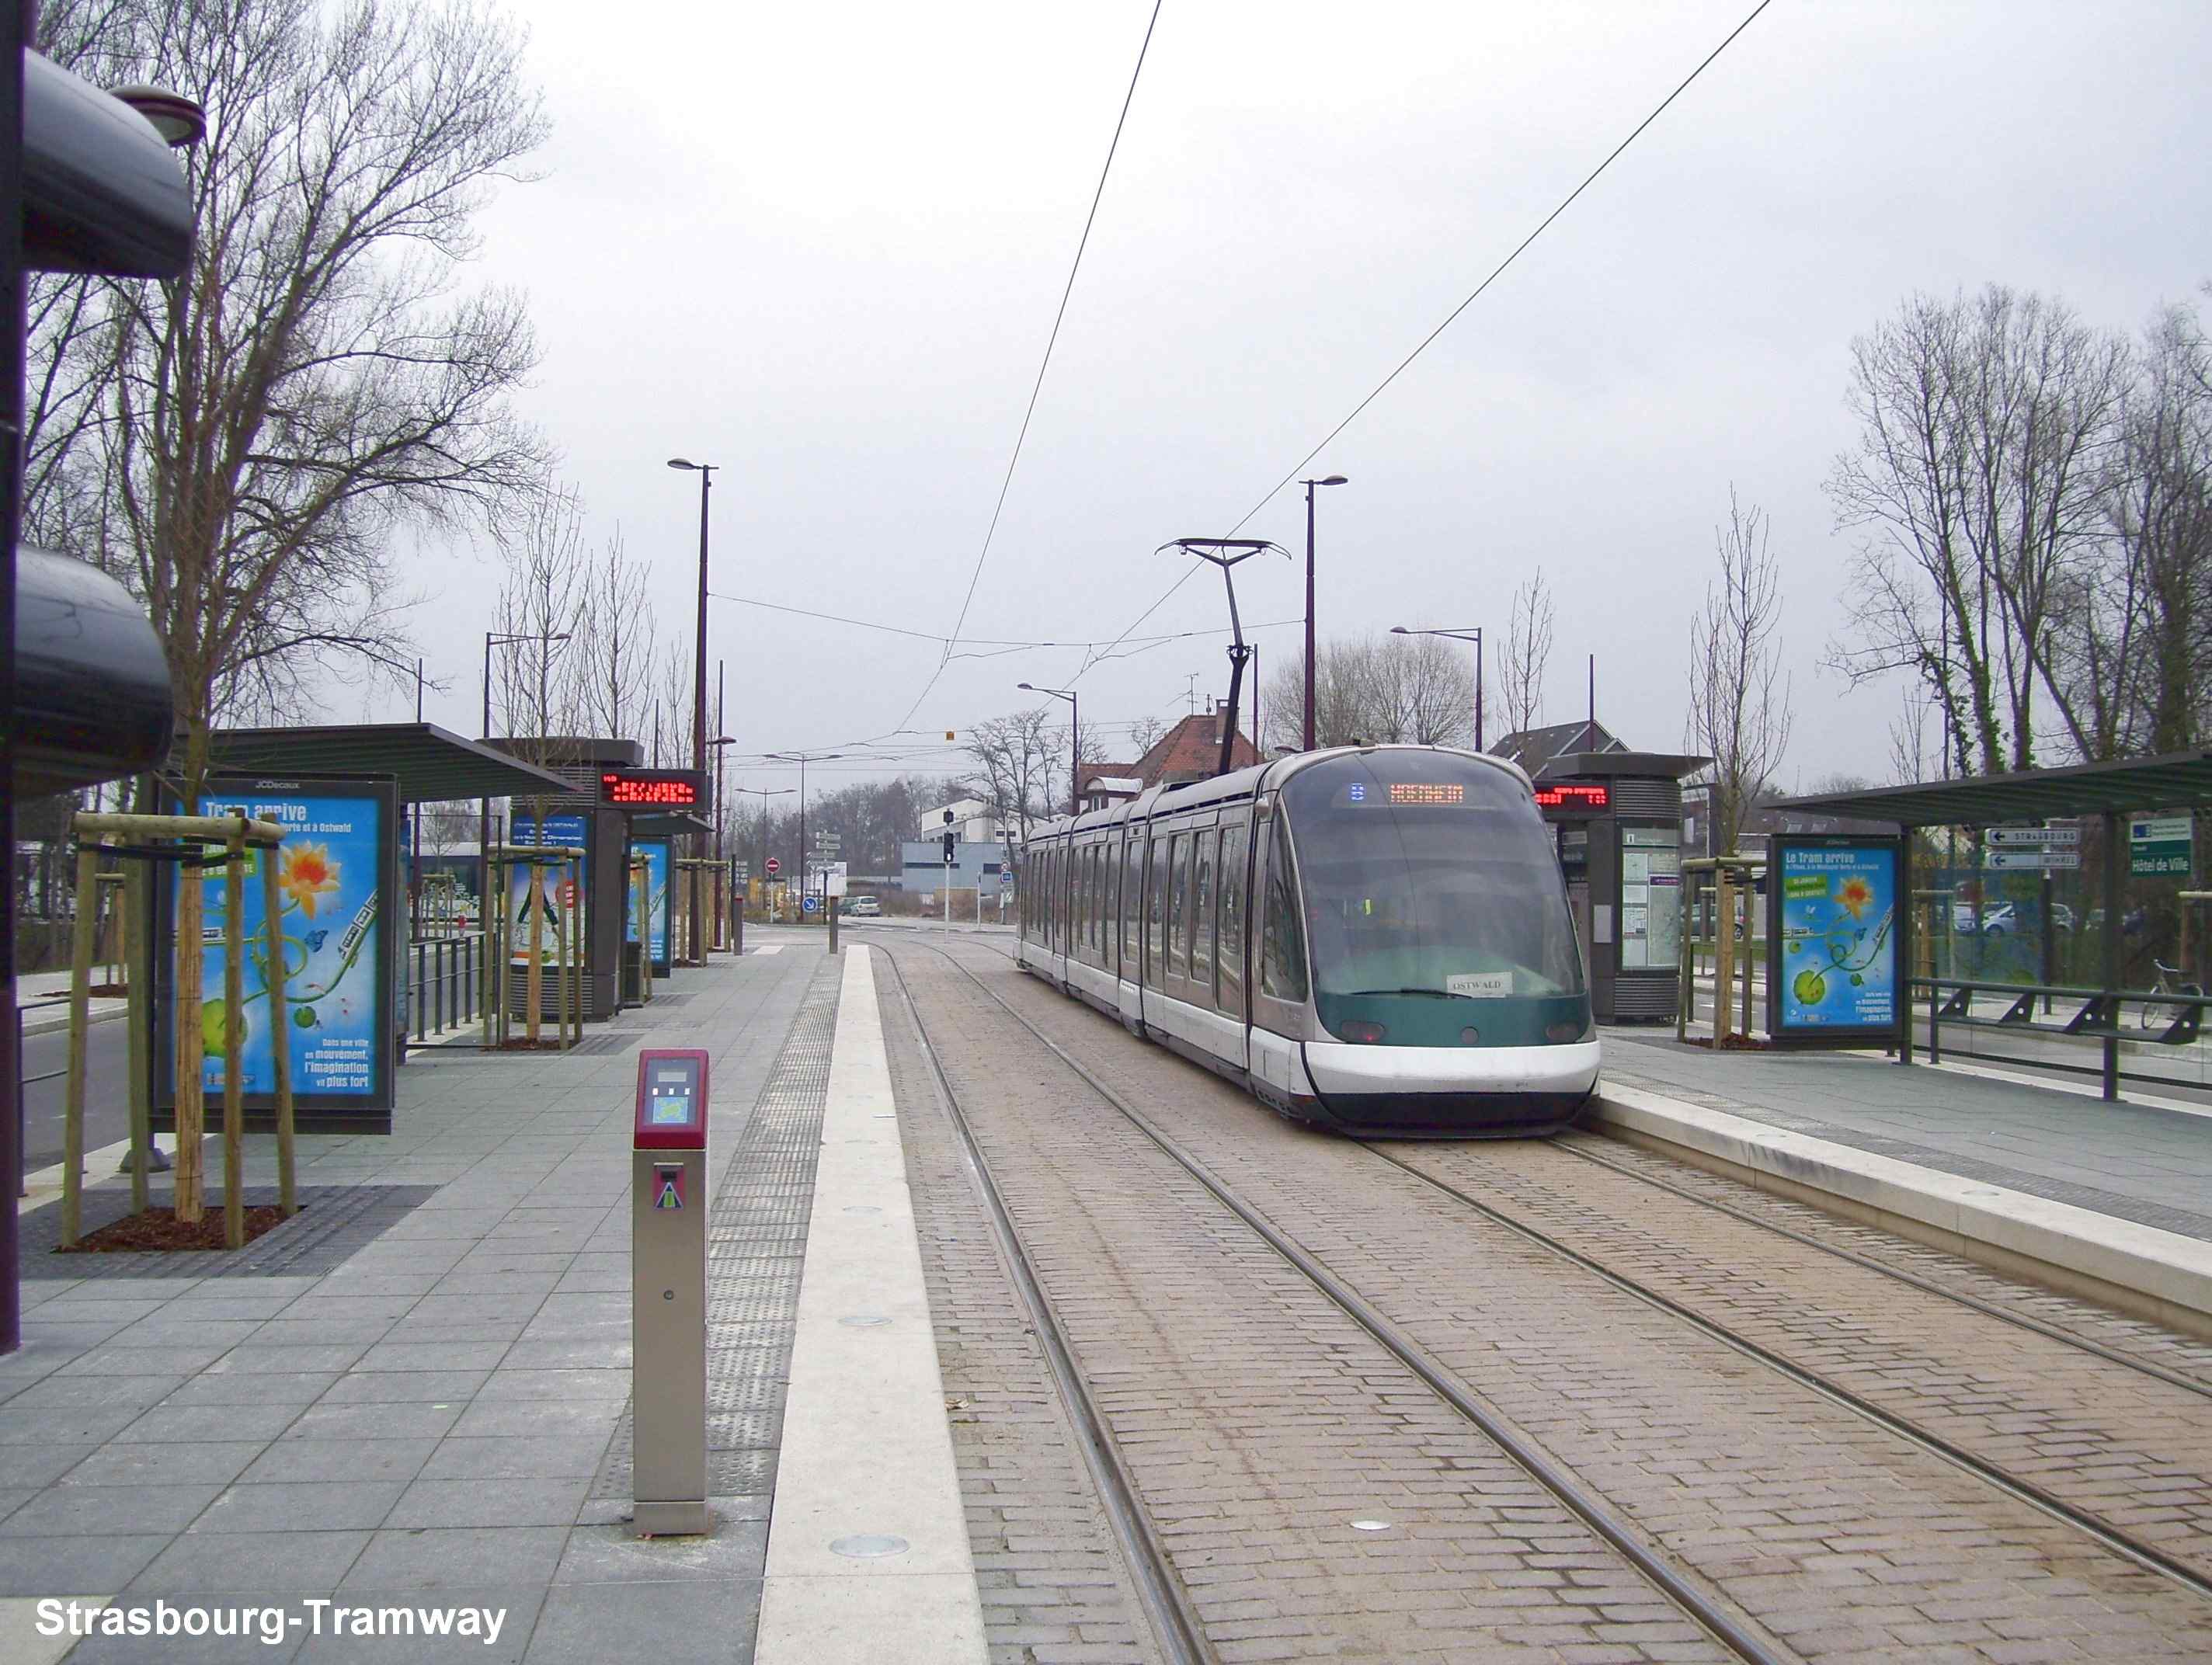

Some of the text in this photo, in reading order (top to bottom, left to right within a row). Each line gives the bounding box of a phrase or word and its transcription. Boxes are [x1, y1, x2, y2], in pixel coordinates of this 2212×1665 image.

[256, 780, 300, 789] JCDecaux
[1390, 784, 1463, 803] HOENHEIM
[1798, 853, 1822, 863] Tram
[1825, 853, 1855, 863] arrive
[1453, 982, 1501, 990] OSTWALD
[304, 1062, 368, 1074] l'imagination
[326, 1076, 348, 1087] plus
[350, 1076, 368, 1087] fort
